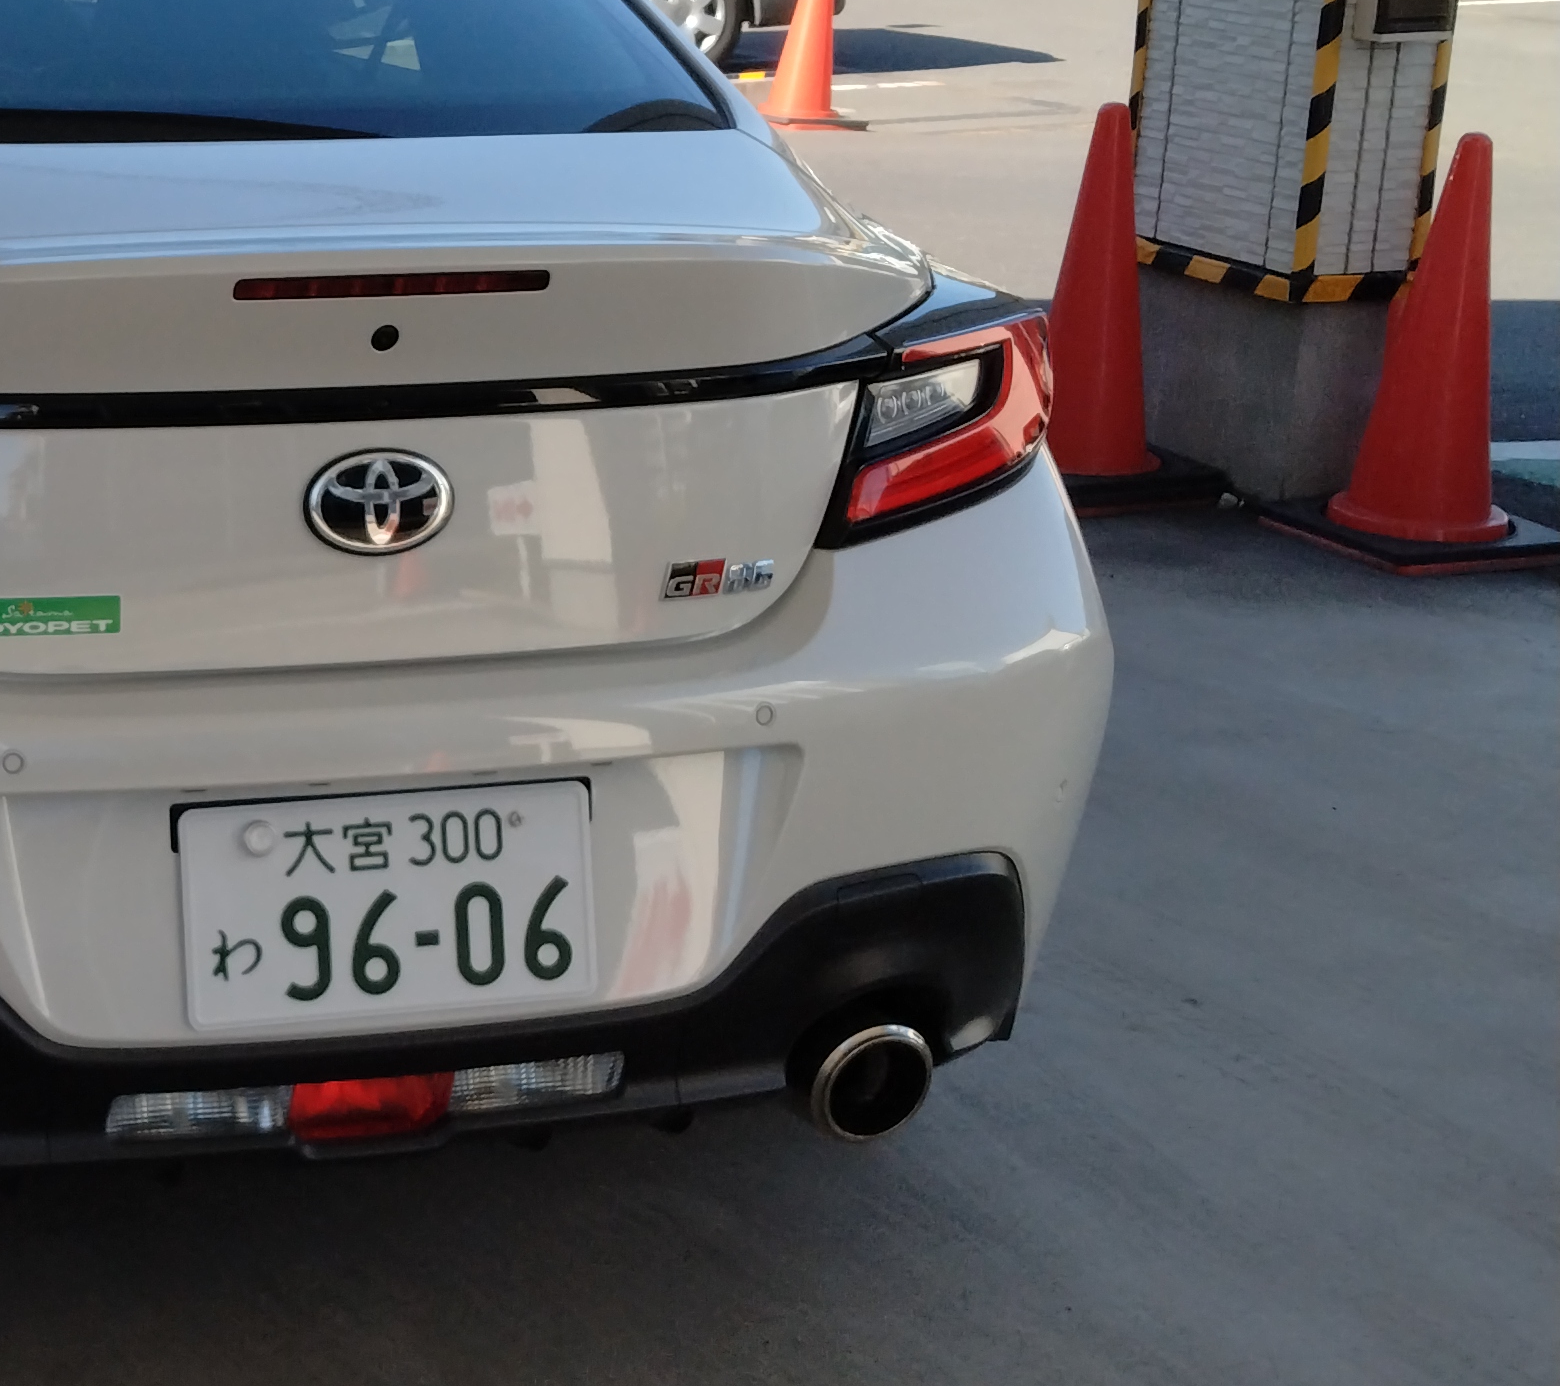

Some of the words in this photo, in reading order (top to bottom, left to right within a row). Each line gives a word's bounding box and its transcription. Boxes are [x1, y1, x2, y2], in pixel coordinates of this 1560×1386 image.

[283, 817, 393, 877] 大宮
[408, 808, 504, 867] 300
[212, 929, 264, 982] わ
[281, 875, 573, 1002] 96-06
